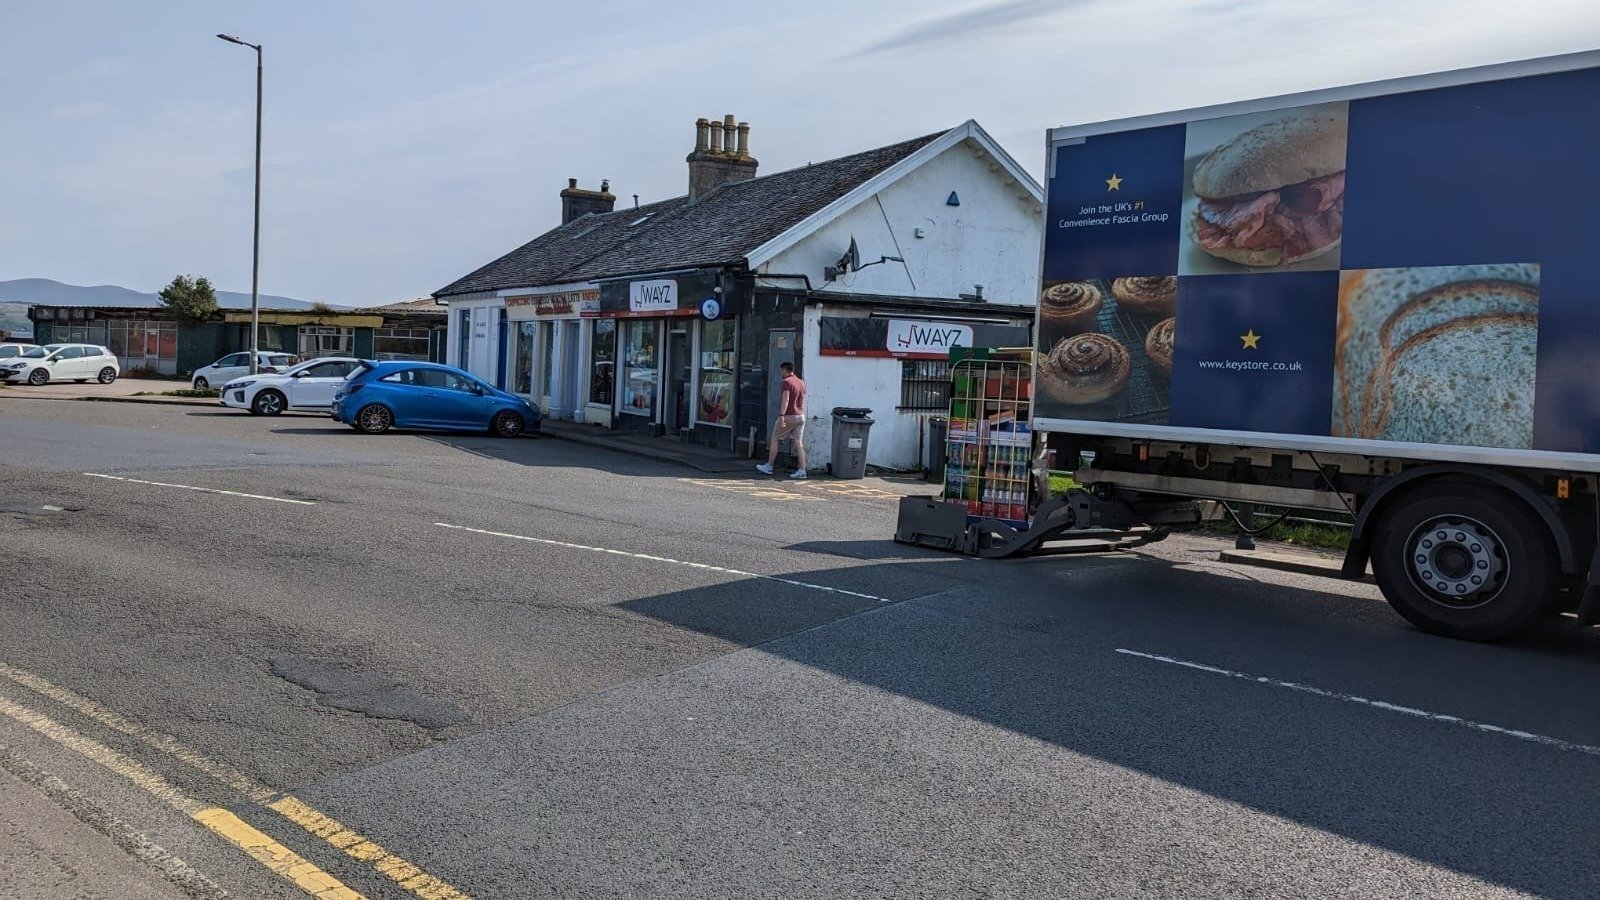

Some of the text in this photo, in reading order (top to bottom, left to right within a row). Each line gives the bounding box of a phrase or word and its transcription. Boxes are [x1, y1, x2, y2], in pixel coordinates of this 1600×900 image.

[1078, 201, 1144, 215] Join the UK's #1
[1059, 212, 1169, 228] Convenience Fascia Group
[1199, 359, 1303, 371] www.keystore.co.uk
